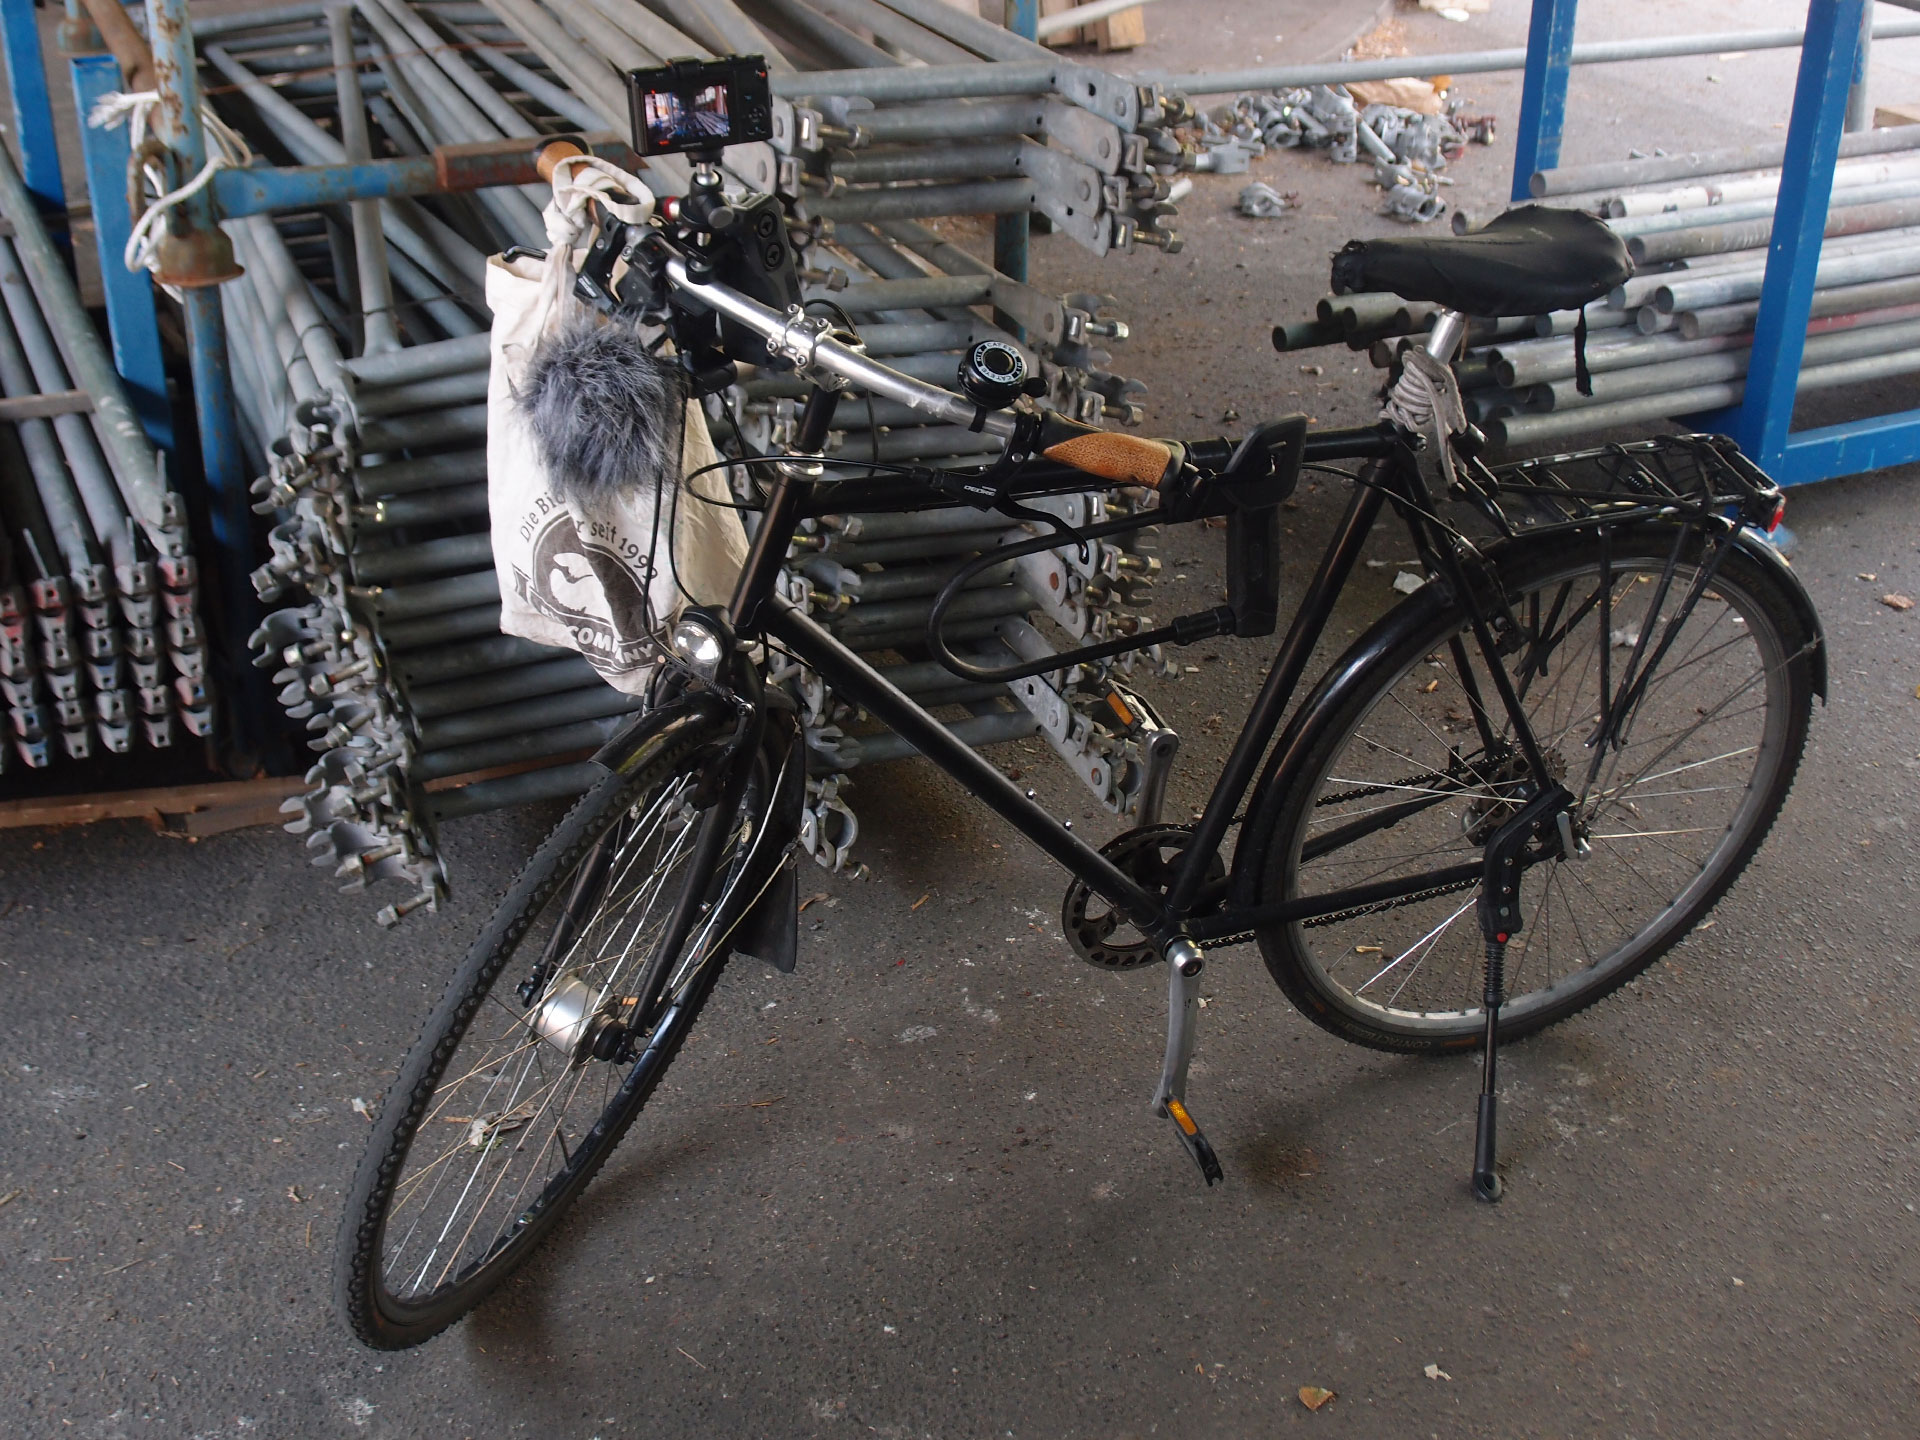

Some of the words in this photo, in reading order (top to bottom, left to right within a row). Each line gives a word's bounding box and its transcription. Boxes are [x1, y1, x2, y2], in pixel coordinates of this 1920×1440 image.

[519, 511, 539, 543] Die
[590, 521, 617, 543] seit
[619, 538, 658, 579] 1999
